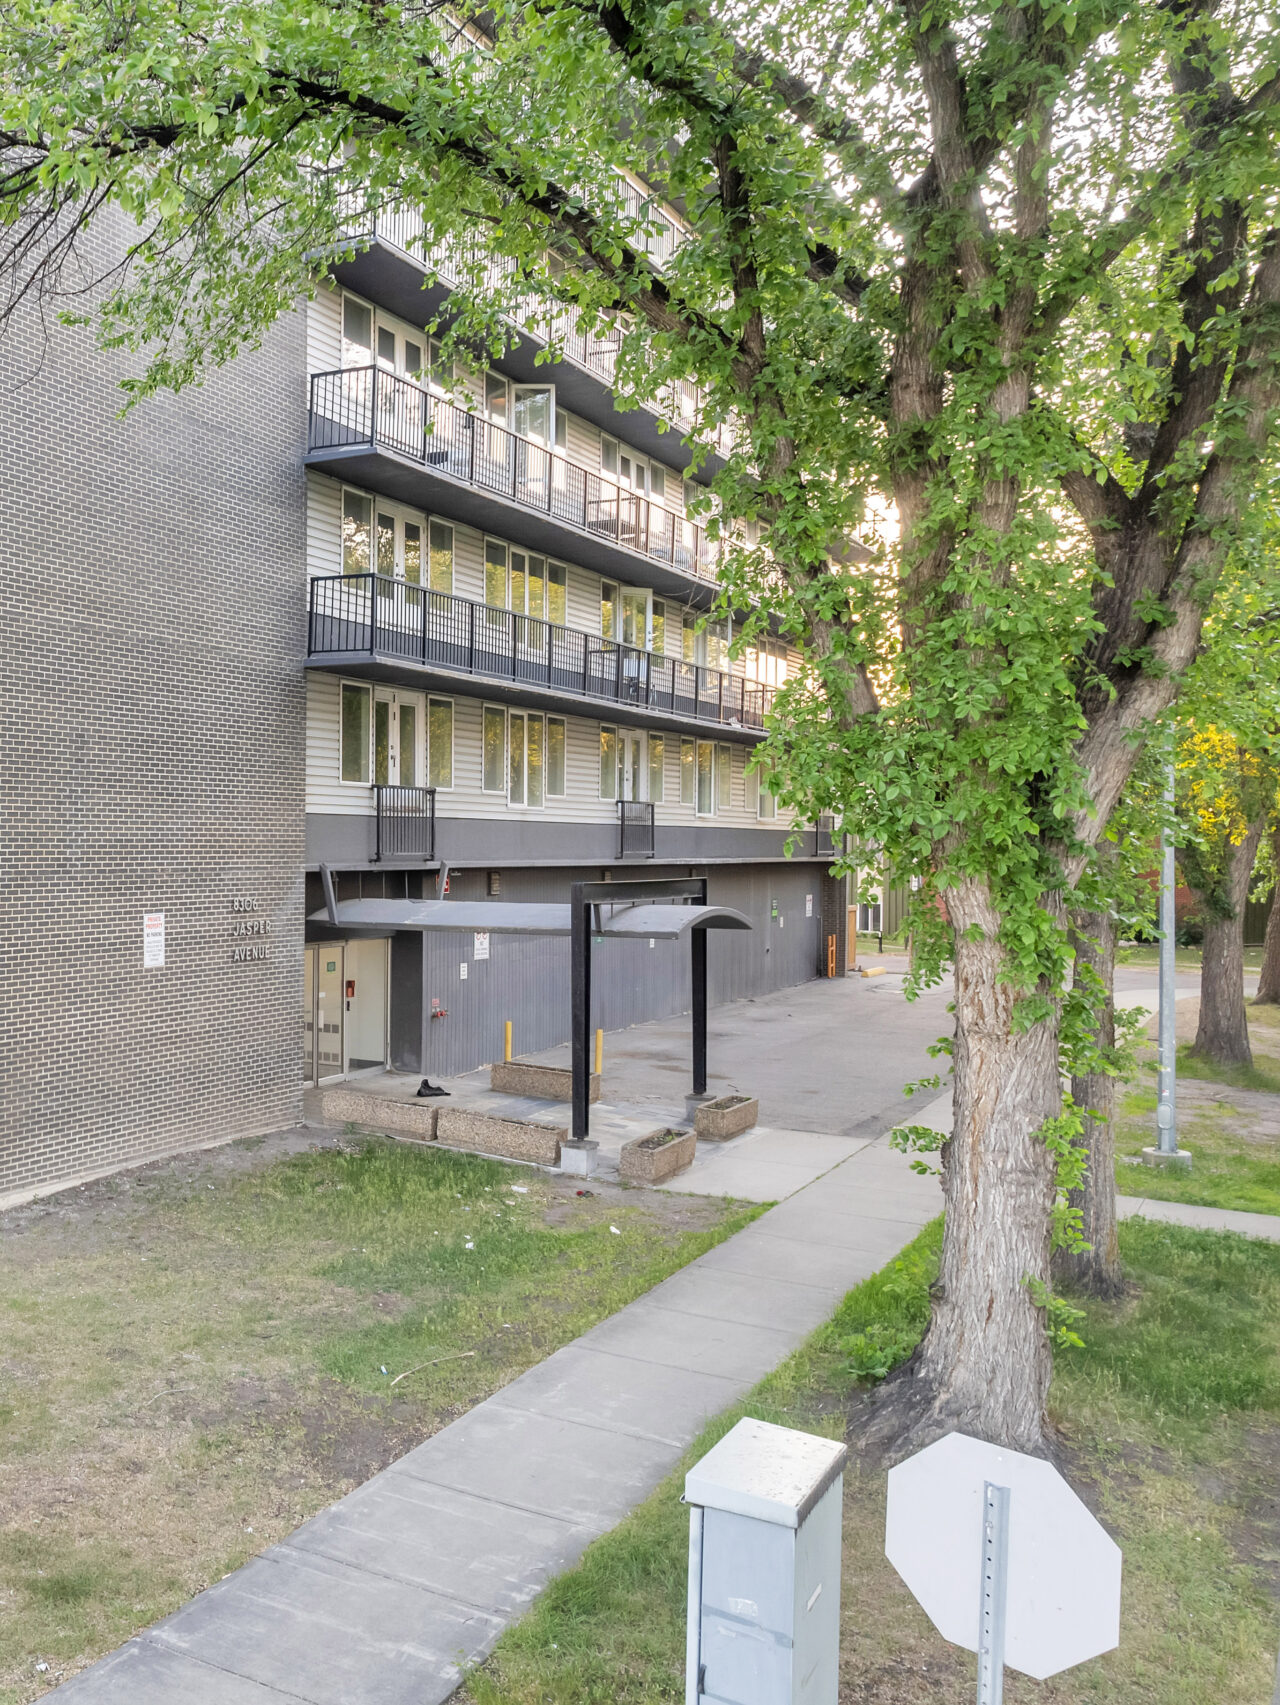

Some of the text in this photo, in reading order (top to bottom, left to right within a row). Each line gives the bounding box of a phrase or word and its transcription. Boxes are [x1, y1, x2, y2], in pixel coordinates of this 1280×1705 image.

[234, 898, 258, 911] 8306
[234, 921, 271, 936] JASPER
[234, 946, 270, 961] AVENUE
